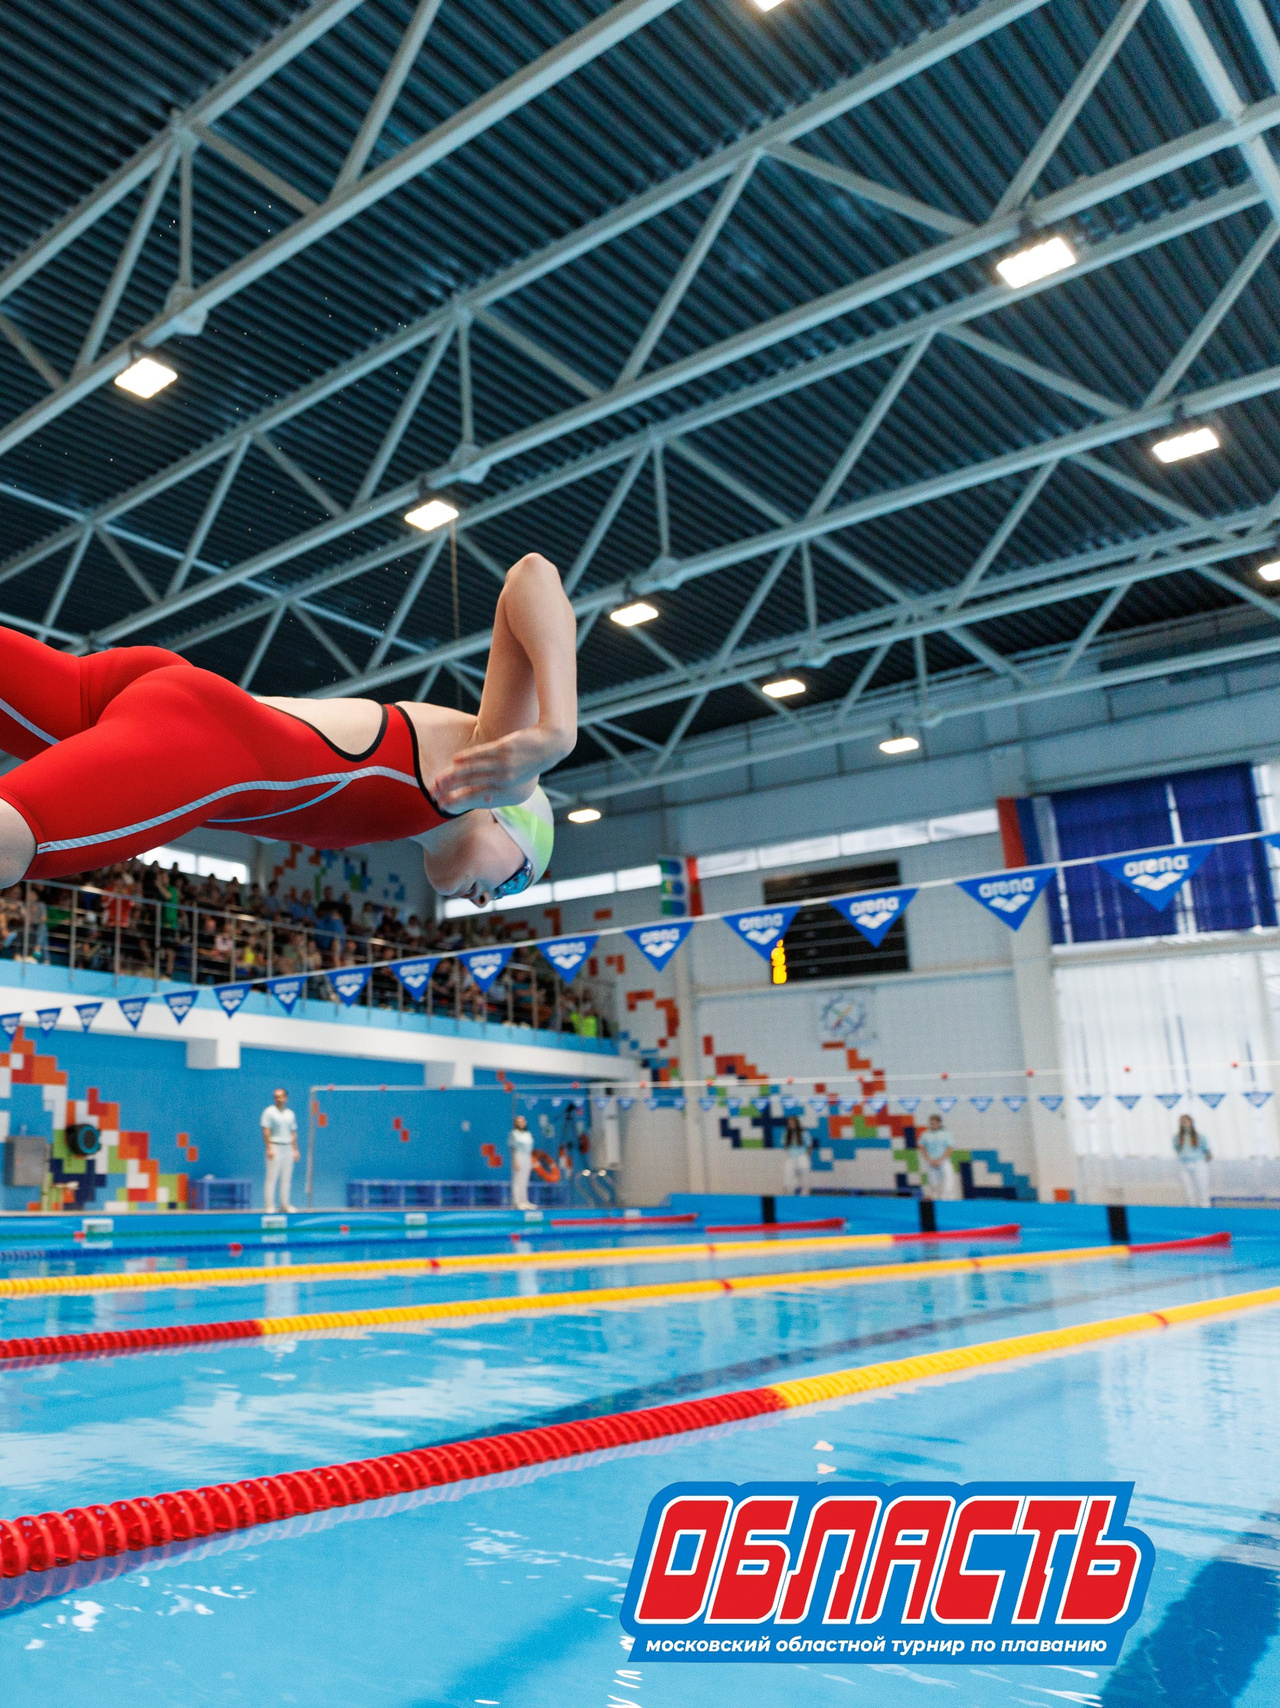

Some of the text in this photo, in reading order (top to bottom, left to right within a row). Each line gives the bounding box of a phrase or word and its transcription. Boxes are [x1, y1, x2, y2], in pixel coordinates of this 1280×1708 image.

[1124, 854, 1190, 877] arena
[978, 877, 1035, 898] arena
[849, 896, 900, 917] arena
